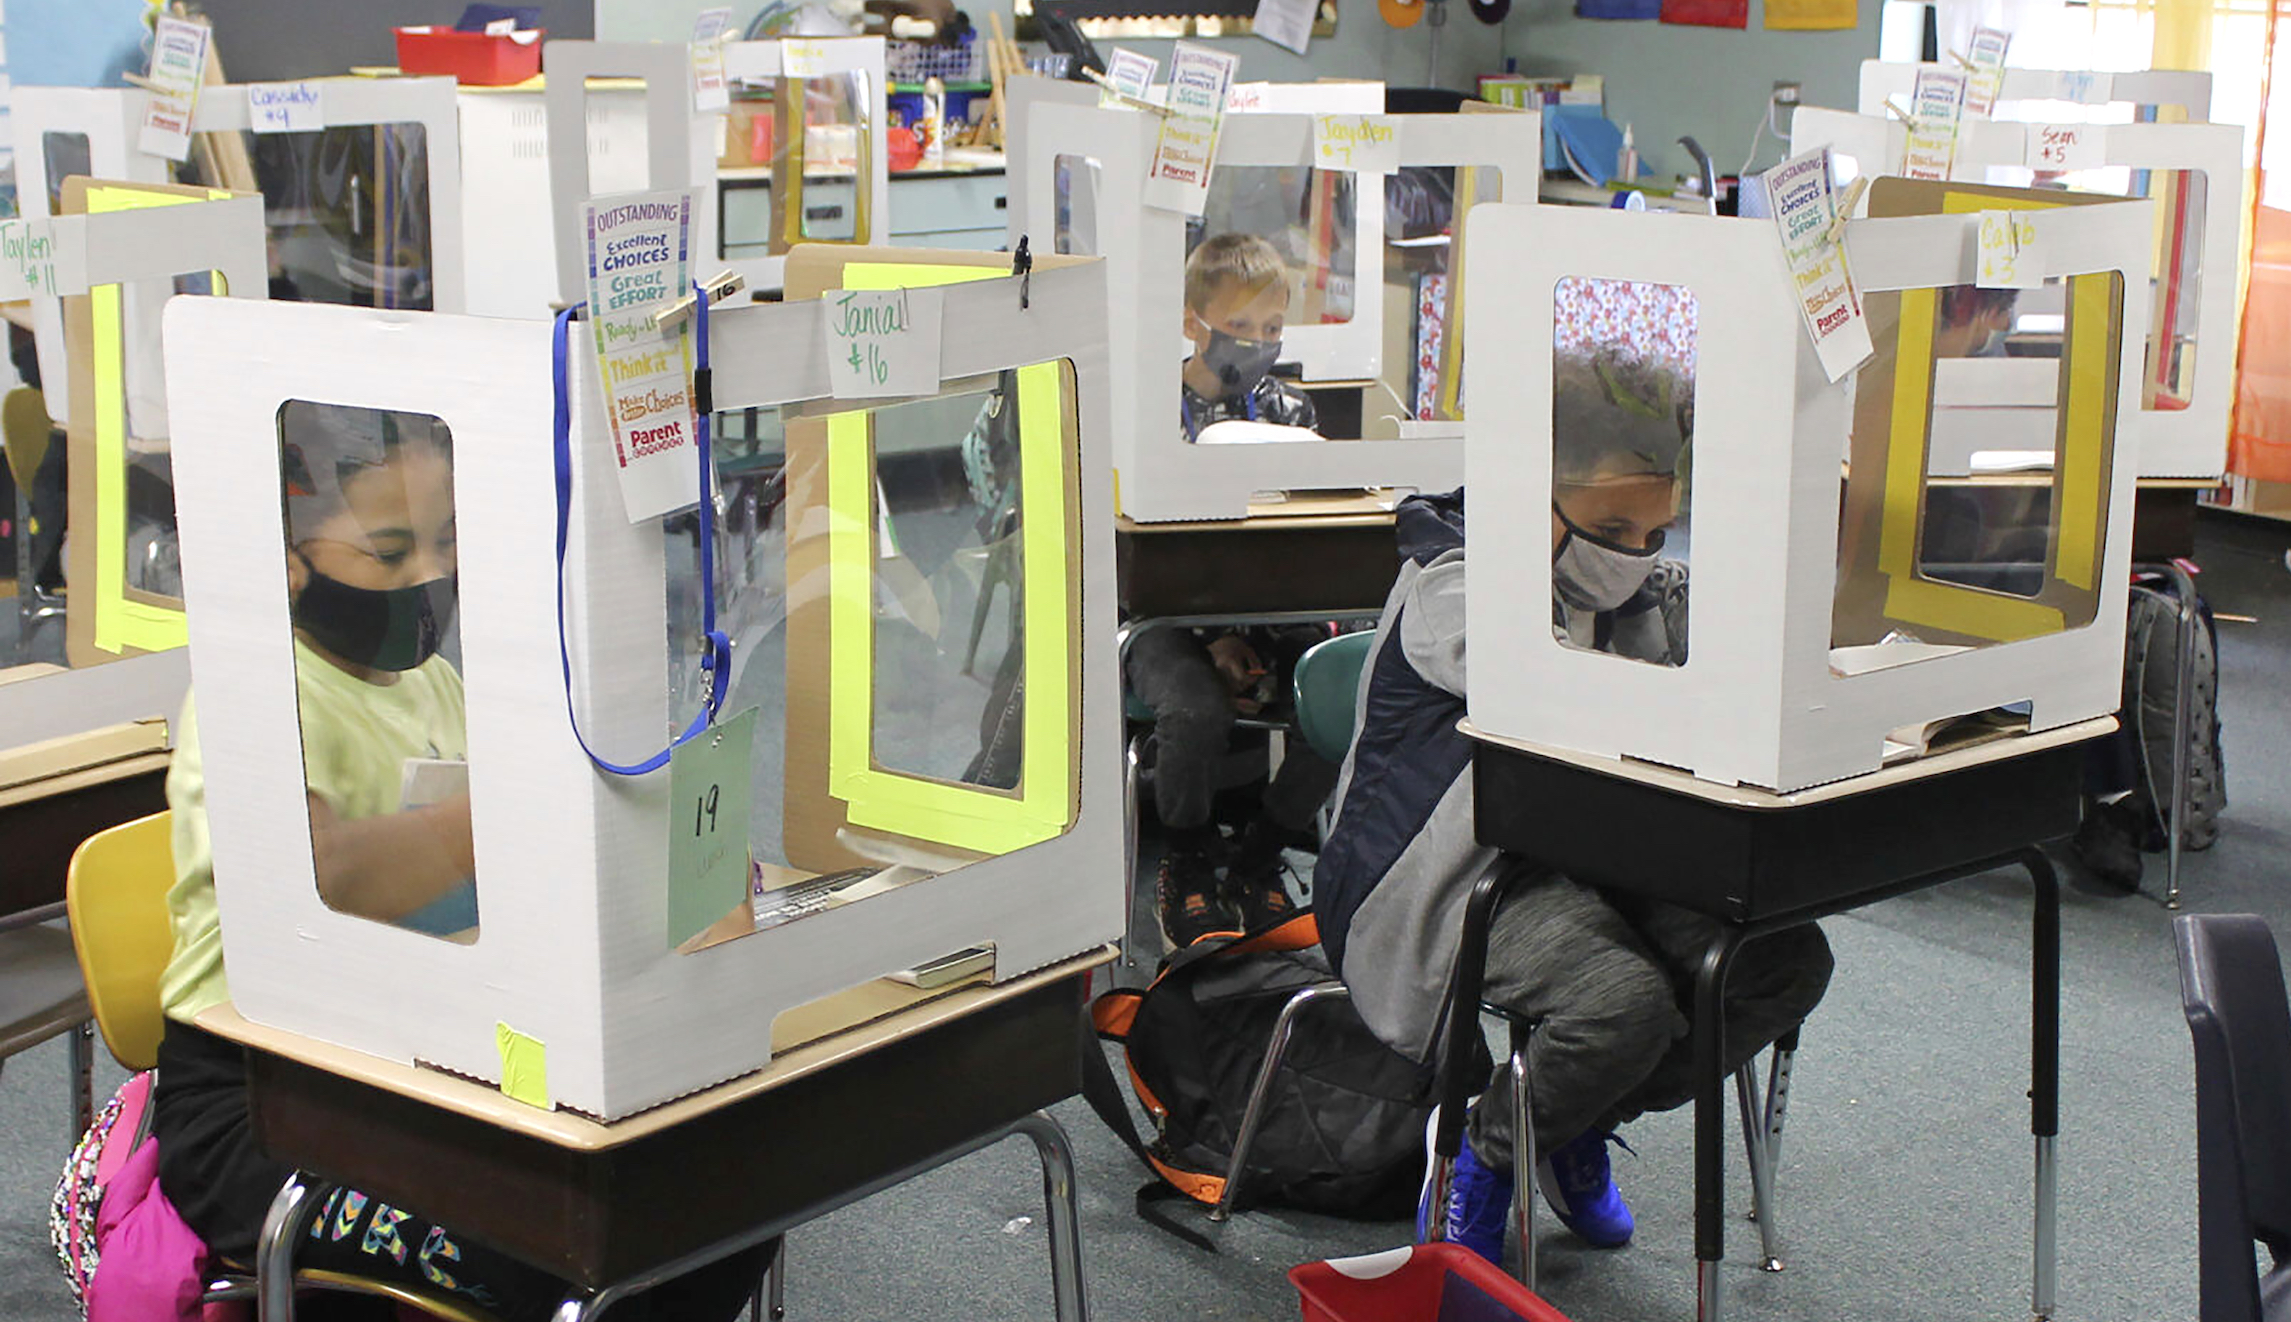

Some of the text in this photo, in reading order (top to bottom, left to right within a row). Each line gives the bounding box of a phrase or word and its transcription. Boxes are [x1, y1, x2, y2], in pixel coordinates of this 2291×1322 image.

[2041, 127, 2078, 146] Sean
[1162, 163, 1196, 178] Parent
[1772, 157, 1821, 191] OUTSTANDING
[1781, 188, 1820, 215] CHOICES
[597, 203, 679, 232] OUTSTANDING
[1788, 205, 1819, 228] Great
[1789, 214, 1823, 241] EFFORT
[606, 234, 668, 255] Excellent
[603, 248, 669, 271] CHOICES
[611, 270, 663, 293] Great
[716, 283, 736, 301] 16
[608, 286, 667, 310] EFFORT
[1816, 304, 1847, 330] Parent
[610, 352, 652, 383] Think
[645, 388, 685, 413] Choices
[630, 421, 682, 448] Parent
[696, 784, 719, 836] 19
